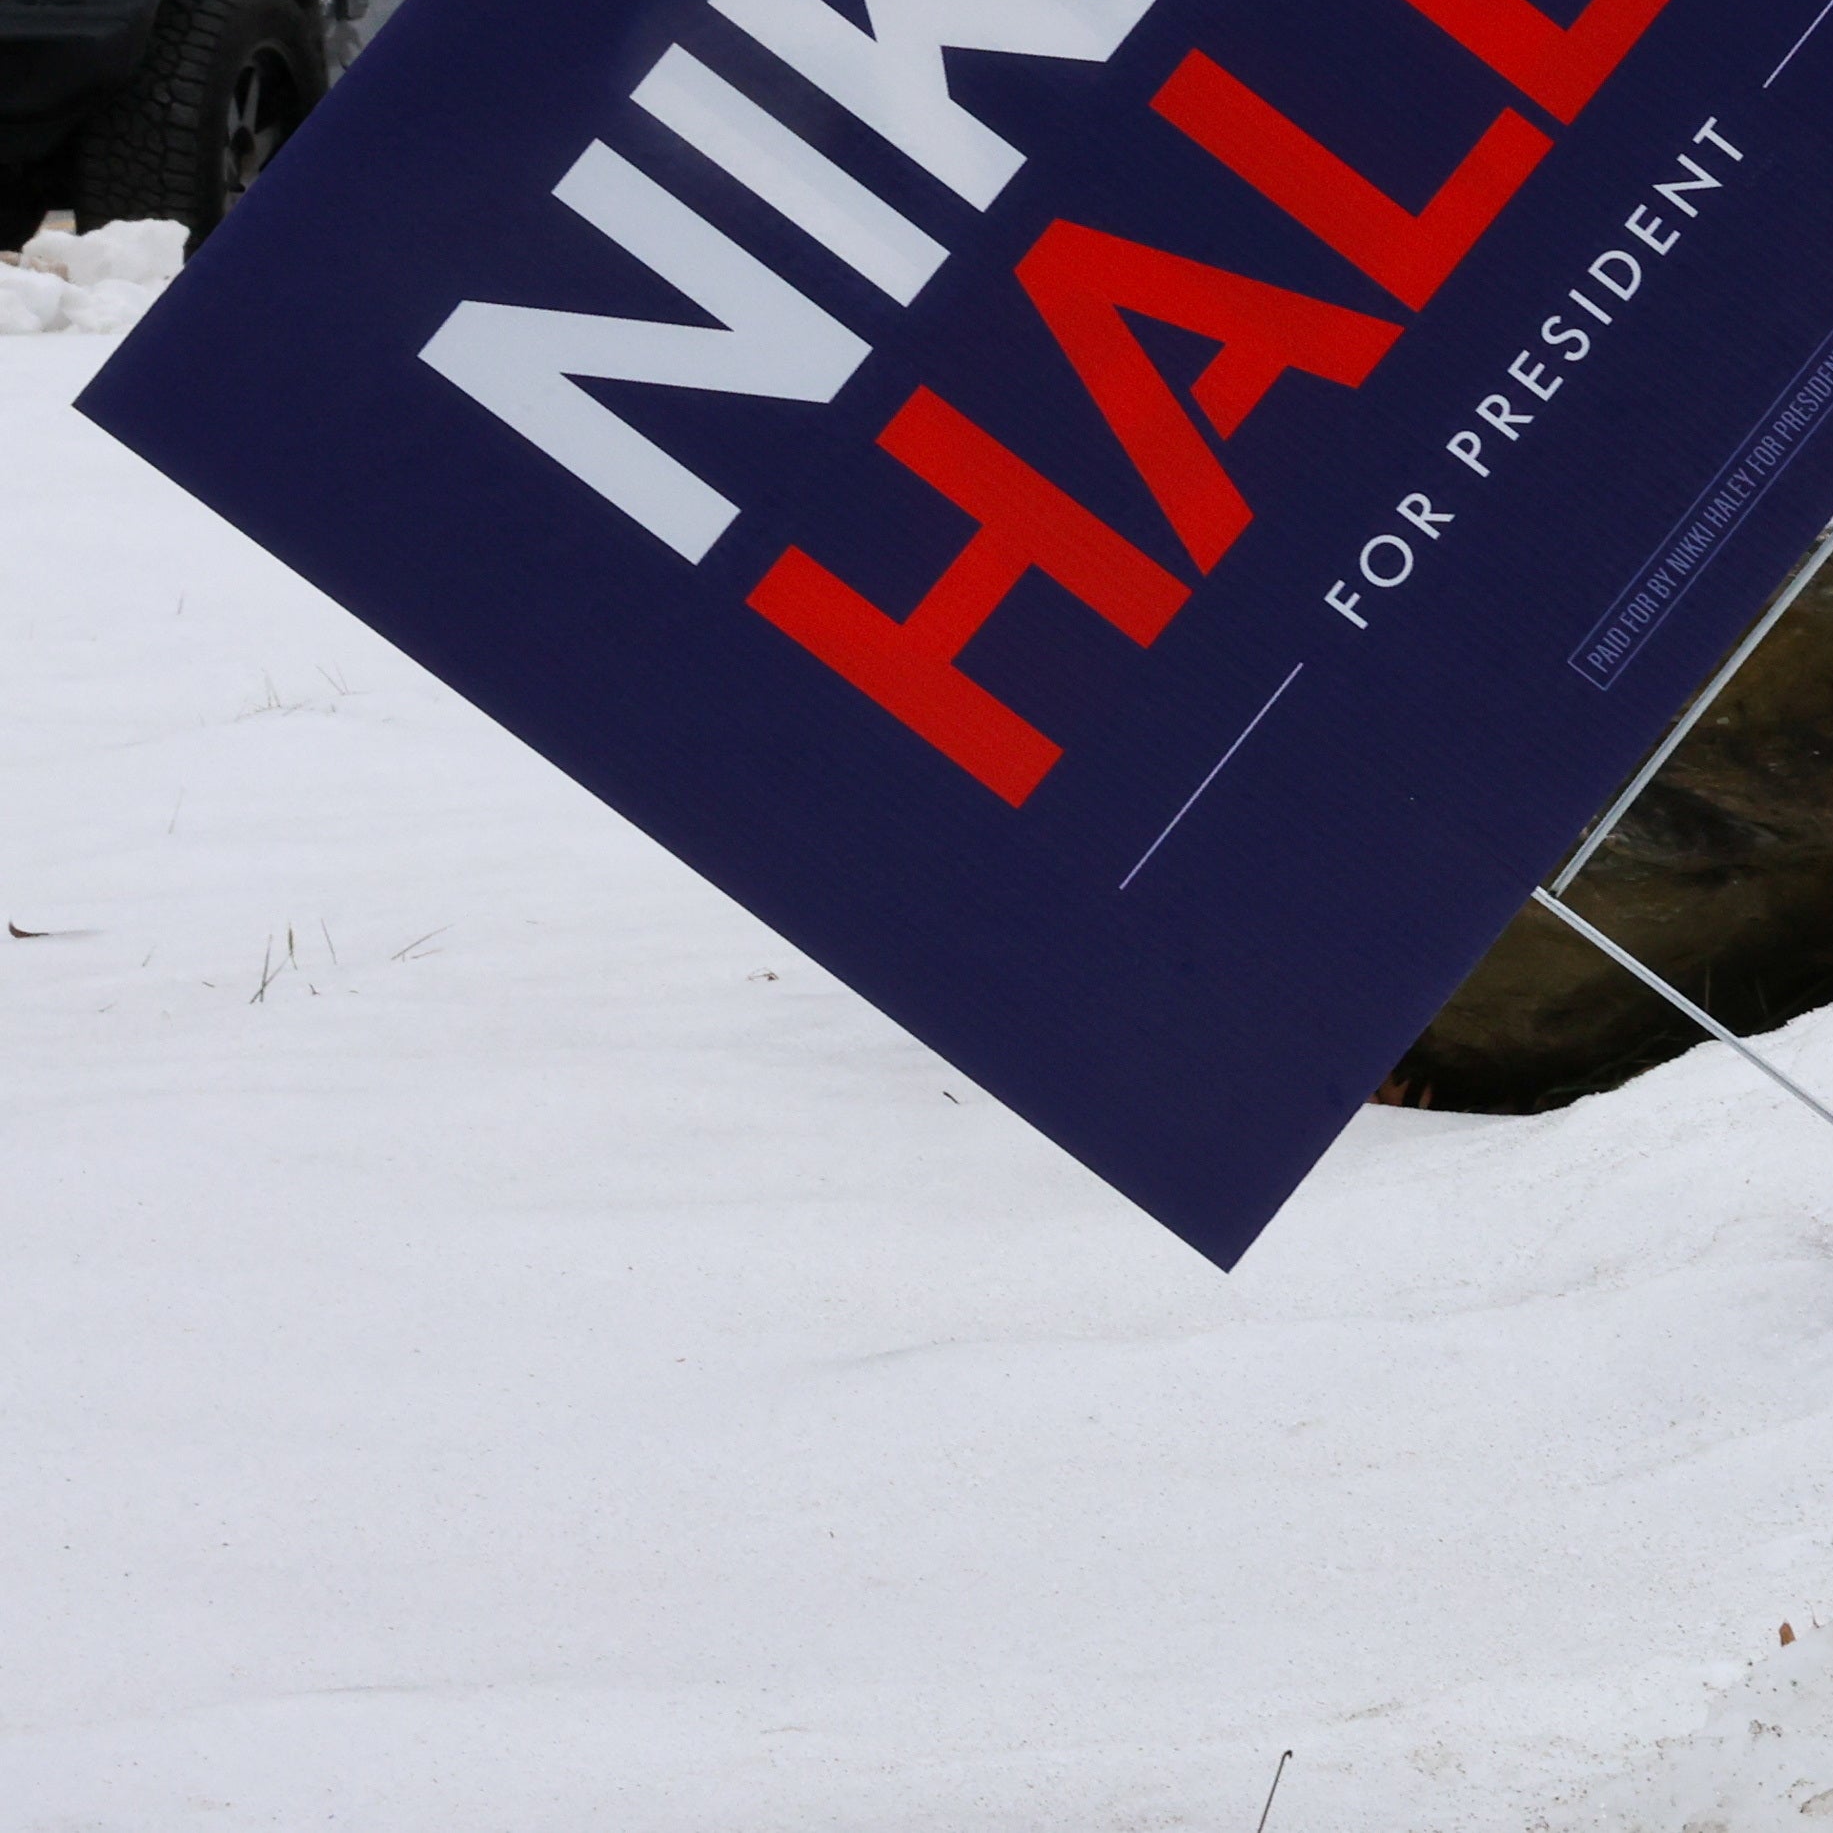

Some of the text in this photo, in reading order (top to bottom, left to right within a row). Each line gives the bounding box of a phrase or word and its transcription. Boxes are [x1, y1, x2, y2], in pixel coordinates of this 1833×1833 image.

[1325, 117, 1743, 629] FOR PRESIDENT
[1586, 627, 1632, 674] PAID
[1619, 592, 1660, 634] FOR
[1646, 568, 1678, 601] BY
[1665, 521, 1716, 577] NIKKI
[1703, 468, 1757, 529] HALEY
[1745, 435, 1786, 477] FOR
